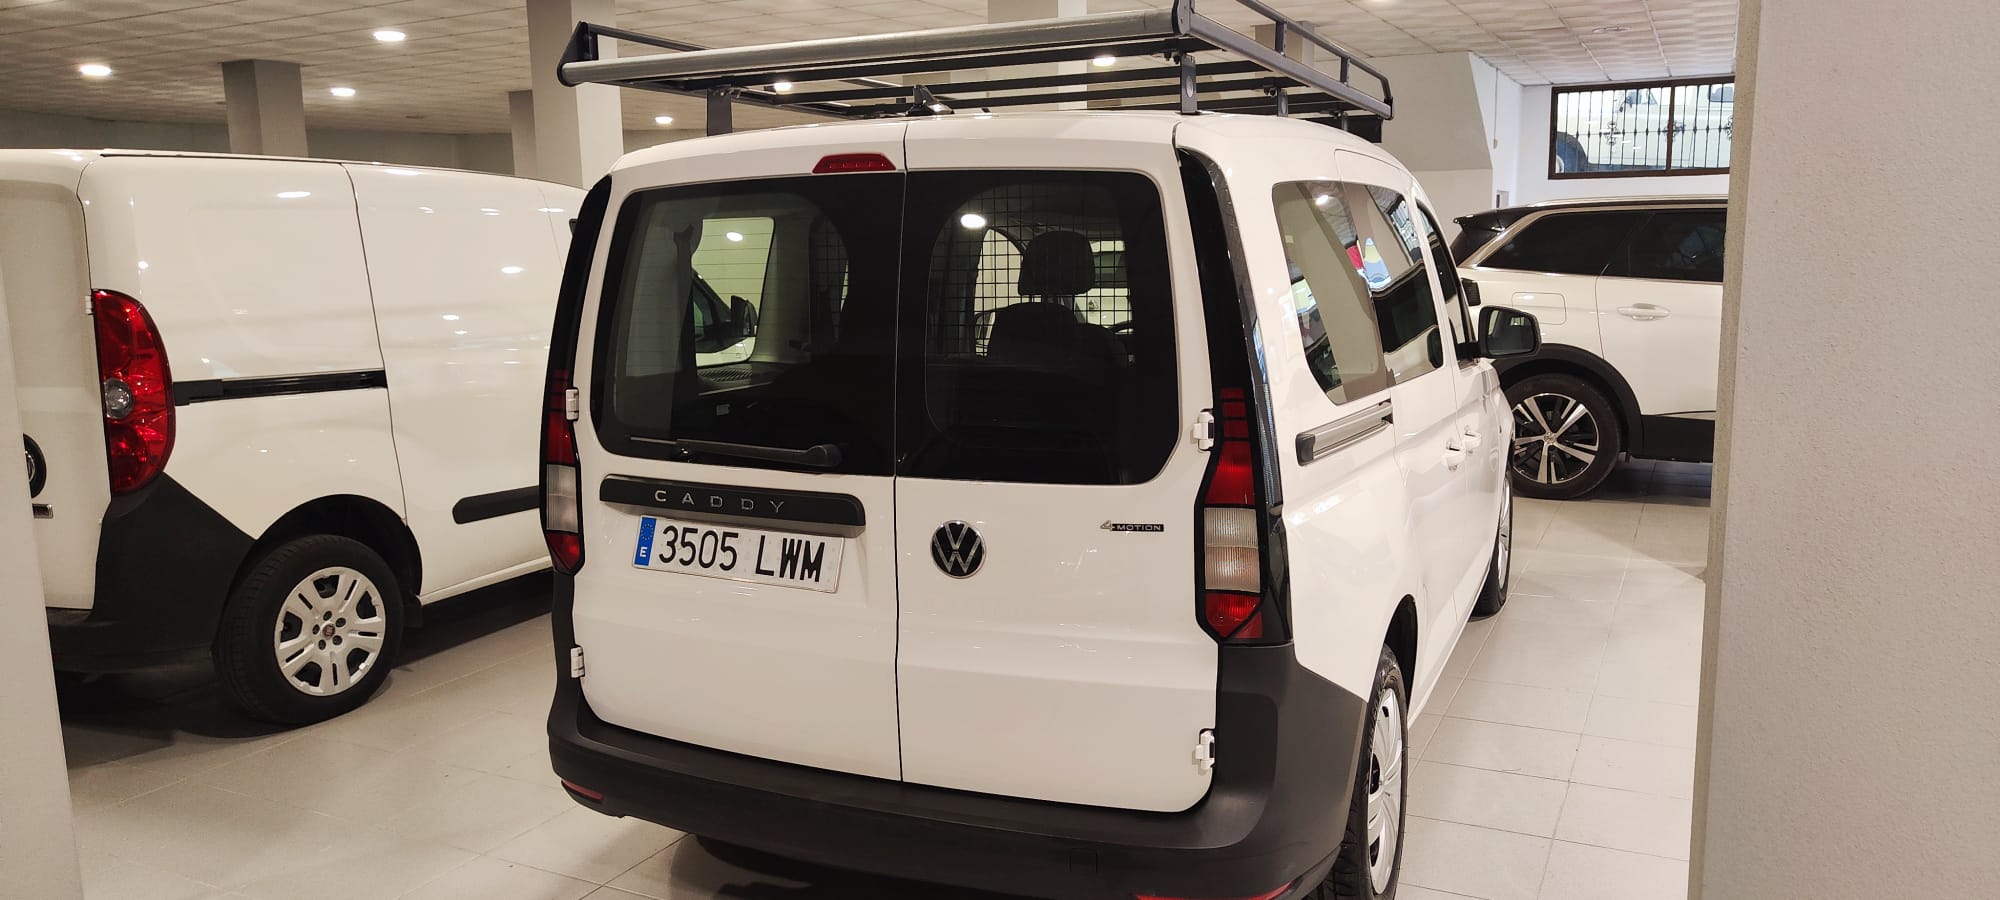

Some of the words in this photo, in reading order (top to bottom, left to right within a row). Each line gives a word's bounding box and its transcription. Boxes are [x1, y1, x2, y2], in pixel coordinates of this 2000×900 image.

[654, 490, 784, 513] CADDY
[639, 546, 648, 558] E
[658, 525, 739, 571] 3505
[755, 534, 825, 582] LWM
